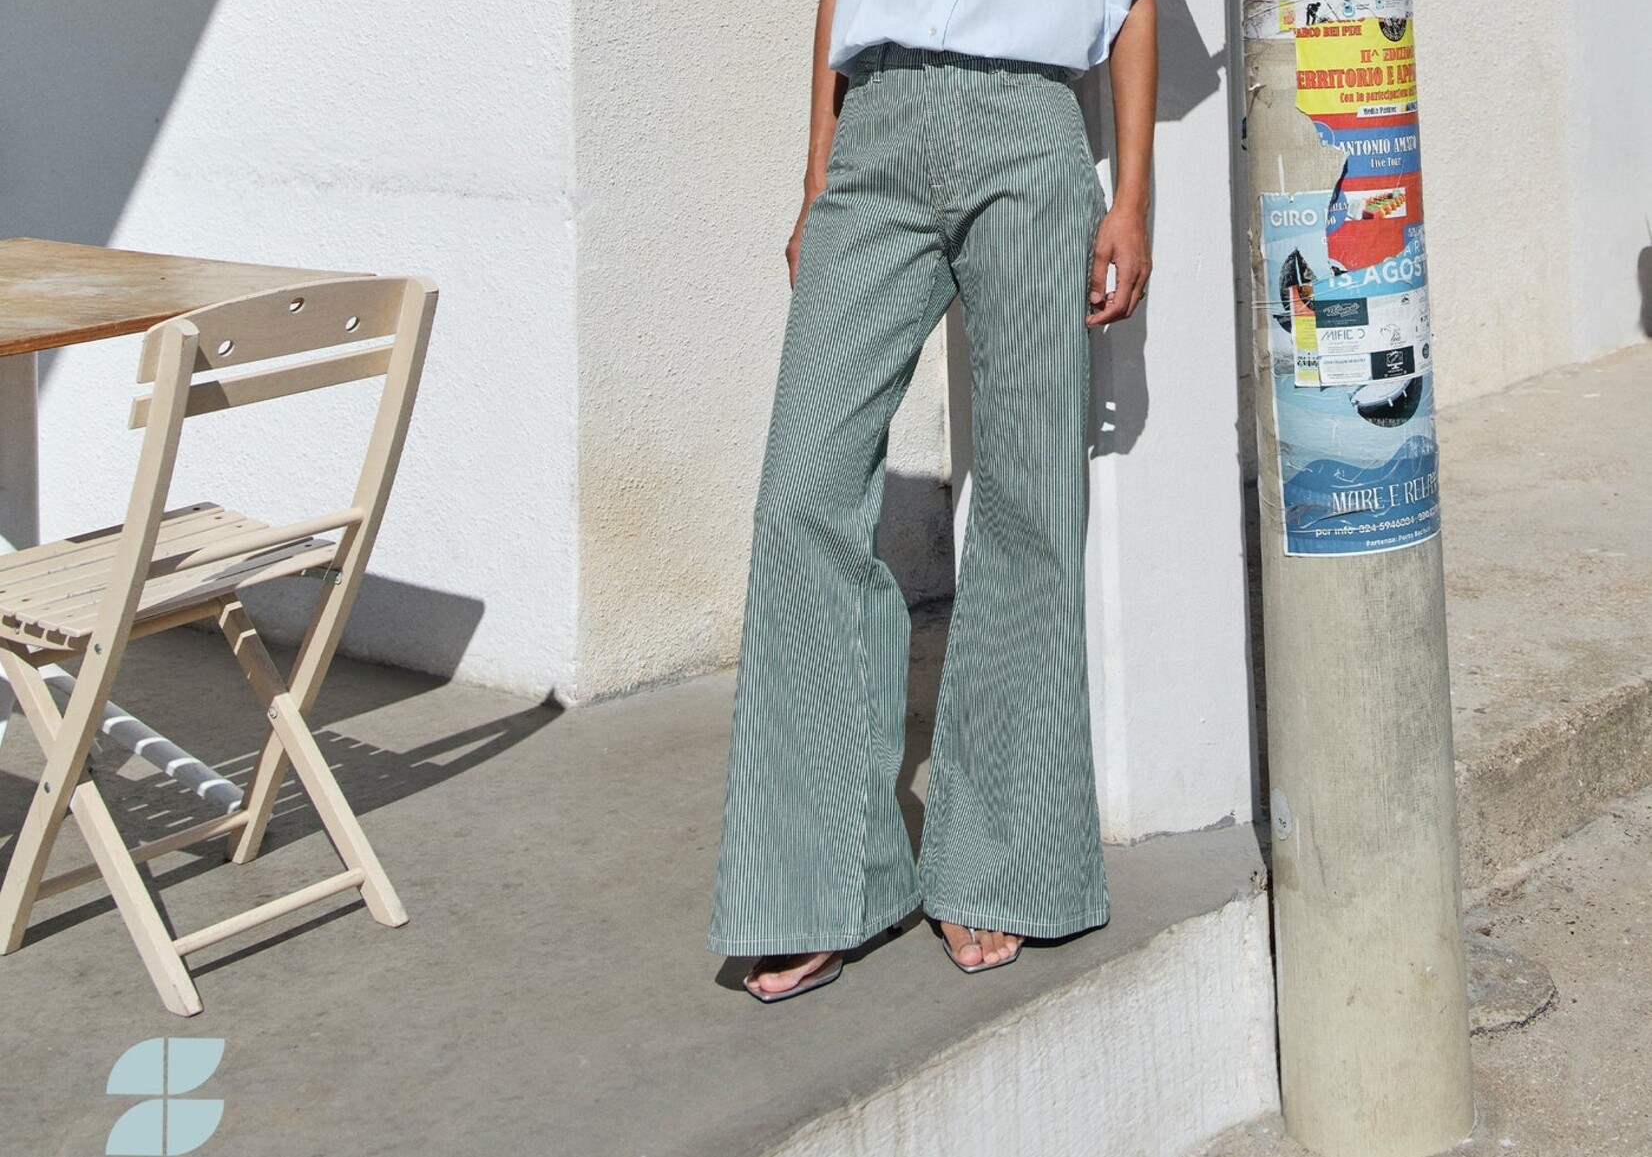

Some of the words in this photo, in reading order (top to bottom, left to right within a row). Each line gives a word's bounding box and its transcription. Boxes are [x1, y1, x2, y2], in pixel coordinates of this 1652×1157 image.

[1294, 27, 1321, 39] ARCO
[1387, 66, 1395, 86] E
[1340, 92, 1354, 103] Con
[1339, 139, 1391, 157] ANTONIO
[1371, 158, 1386, 168] Live
[1332, 487, 1385, 513] MARE
[1389, 484, 1400, 507] E
[1315, 529, 1331, 537] per
[1334, 525, 1354, 536] info
